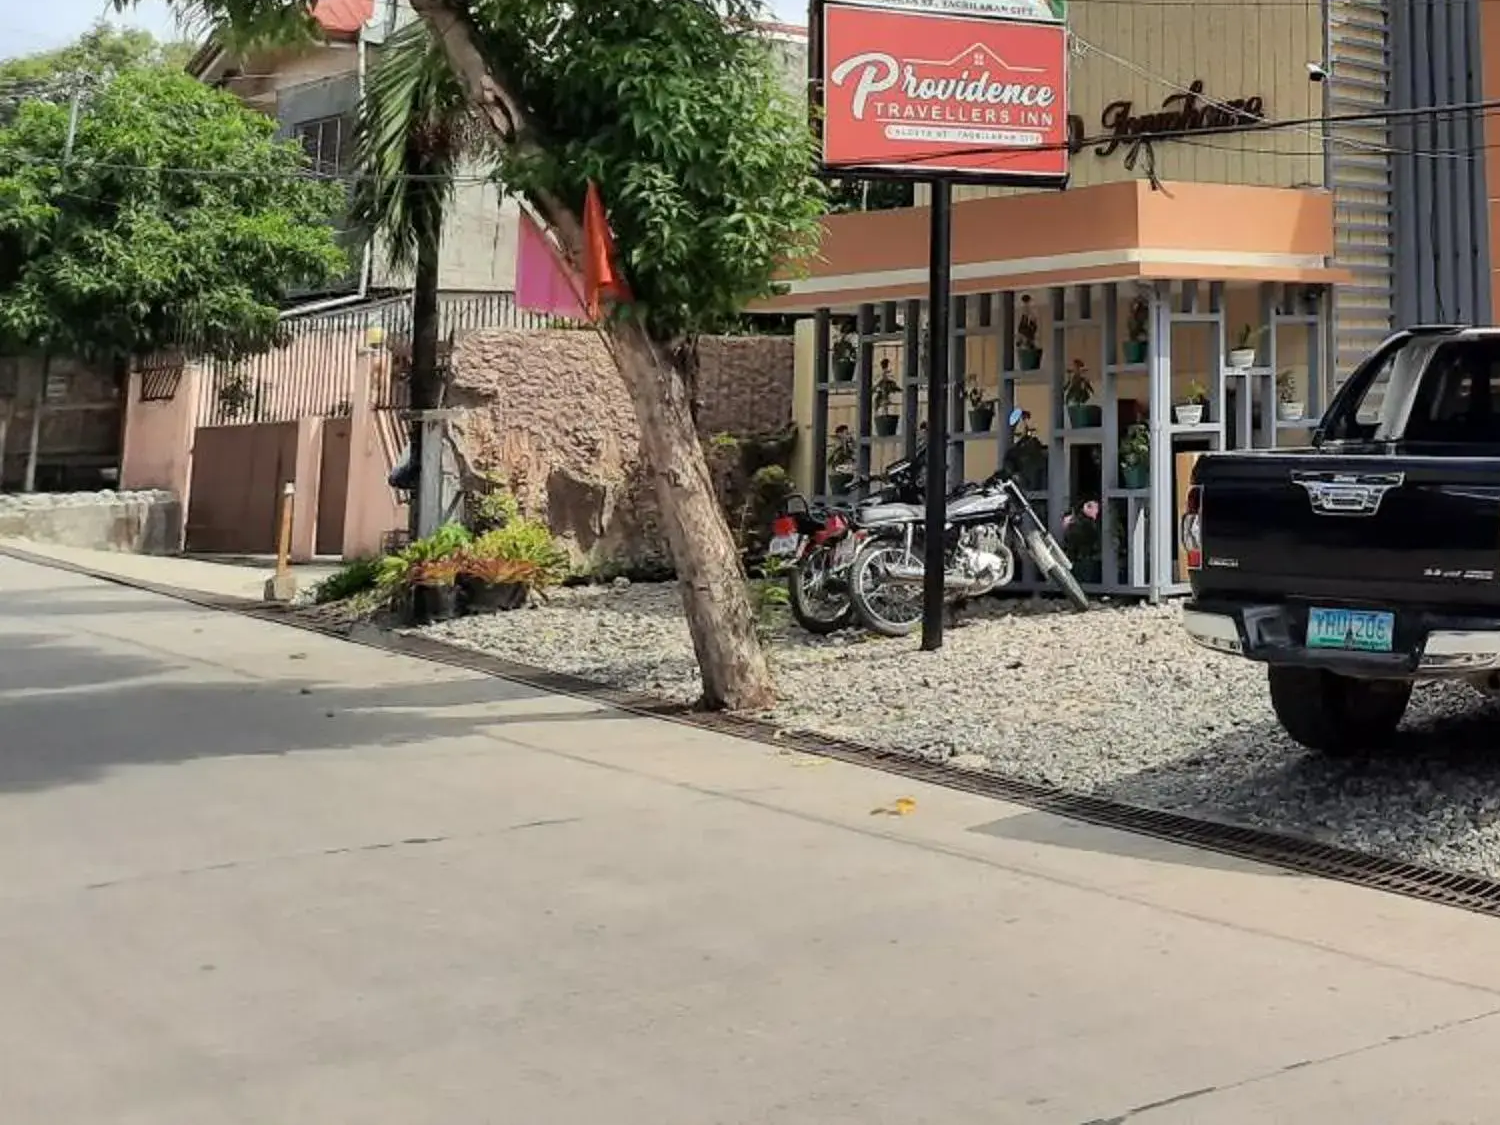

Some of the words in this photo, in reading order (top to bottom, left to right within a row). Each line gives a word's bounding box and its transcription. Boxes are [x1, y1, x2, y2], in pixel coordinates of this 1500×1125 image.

[831, 52, 1055, 119] Providence
[874, 101, 1010, 124] TRAVELLERS
[1020, 110, 1053, 126] INN
